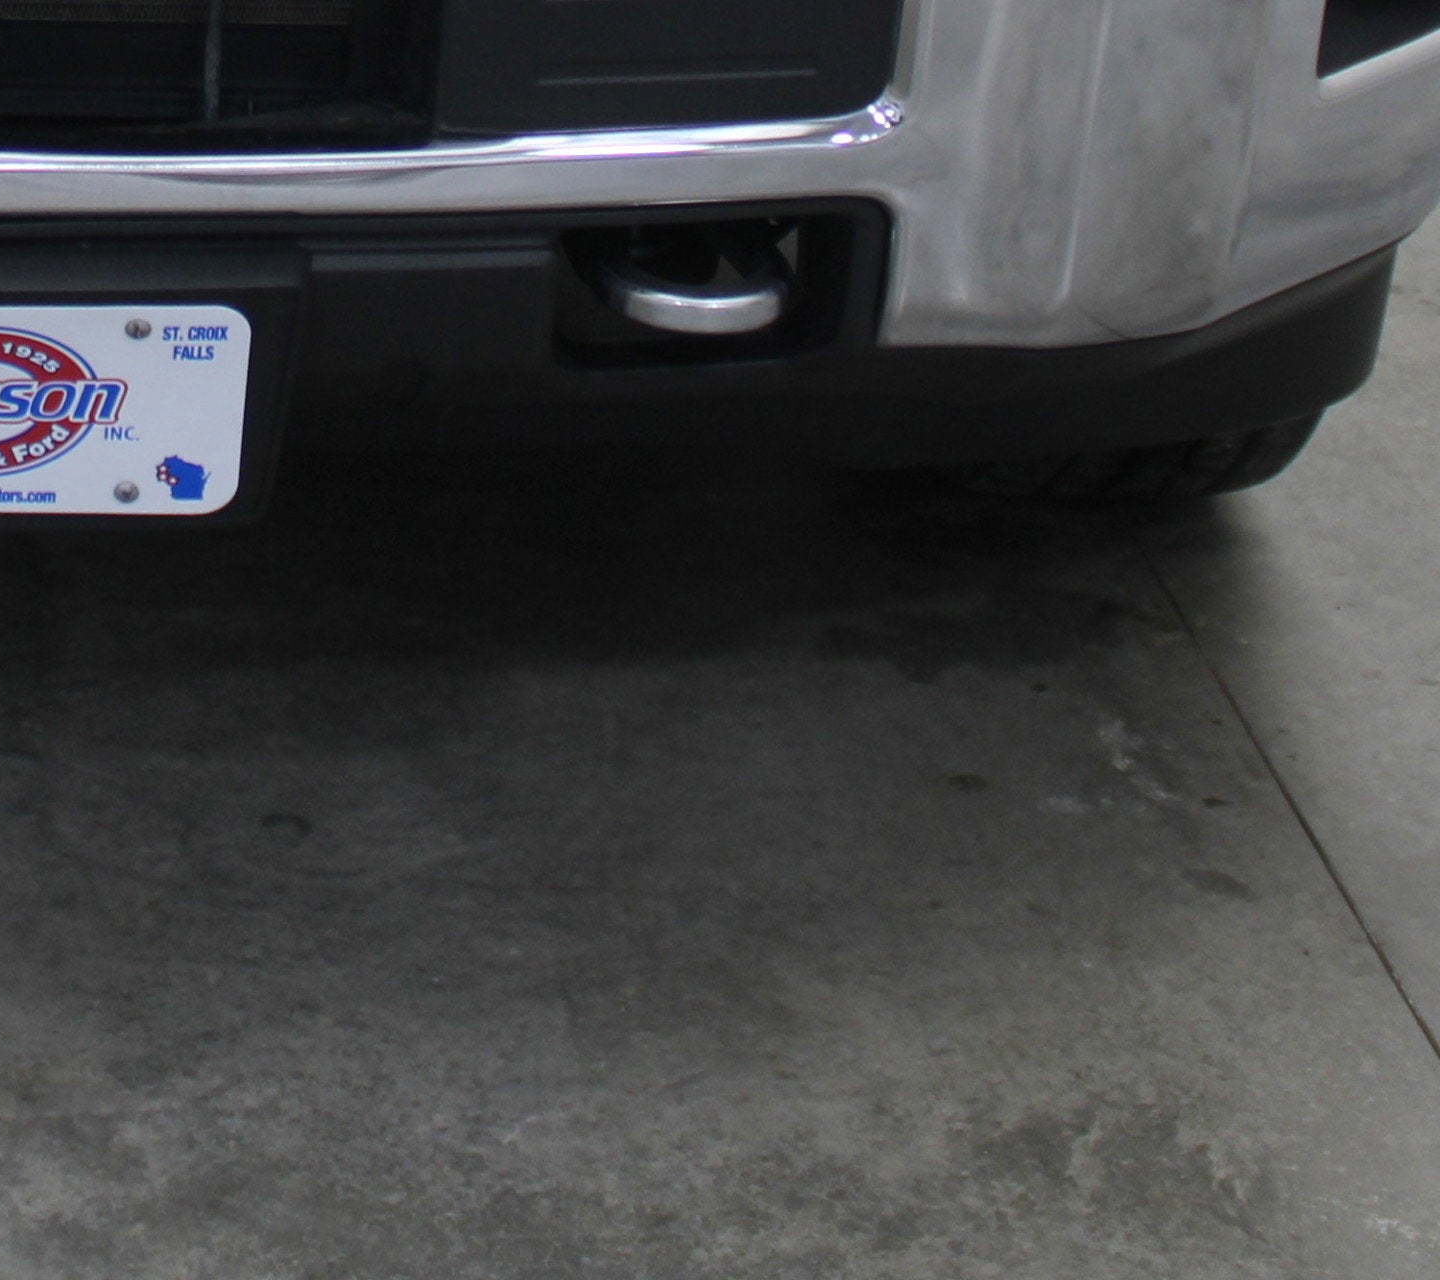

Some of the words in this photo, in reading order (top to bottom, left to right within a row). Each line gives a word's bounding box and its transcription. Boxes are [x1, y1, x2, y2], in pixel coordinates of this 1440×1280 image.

[162, 326, 183, 341] ST.
[187, 326, 229, 341] CROIX
[0, 341, 62, 375] 1925
[173, 345, 215, 360] FALLS
[104, 426, 140, 441] INC.
[11, 424, 71, 465] Ford
